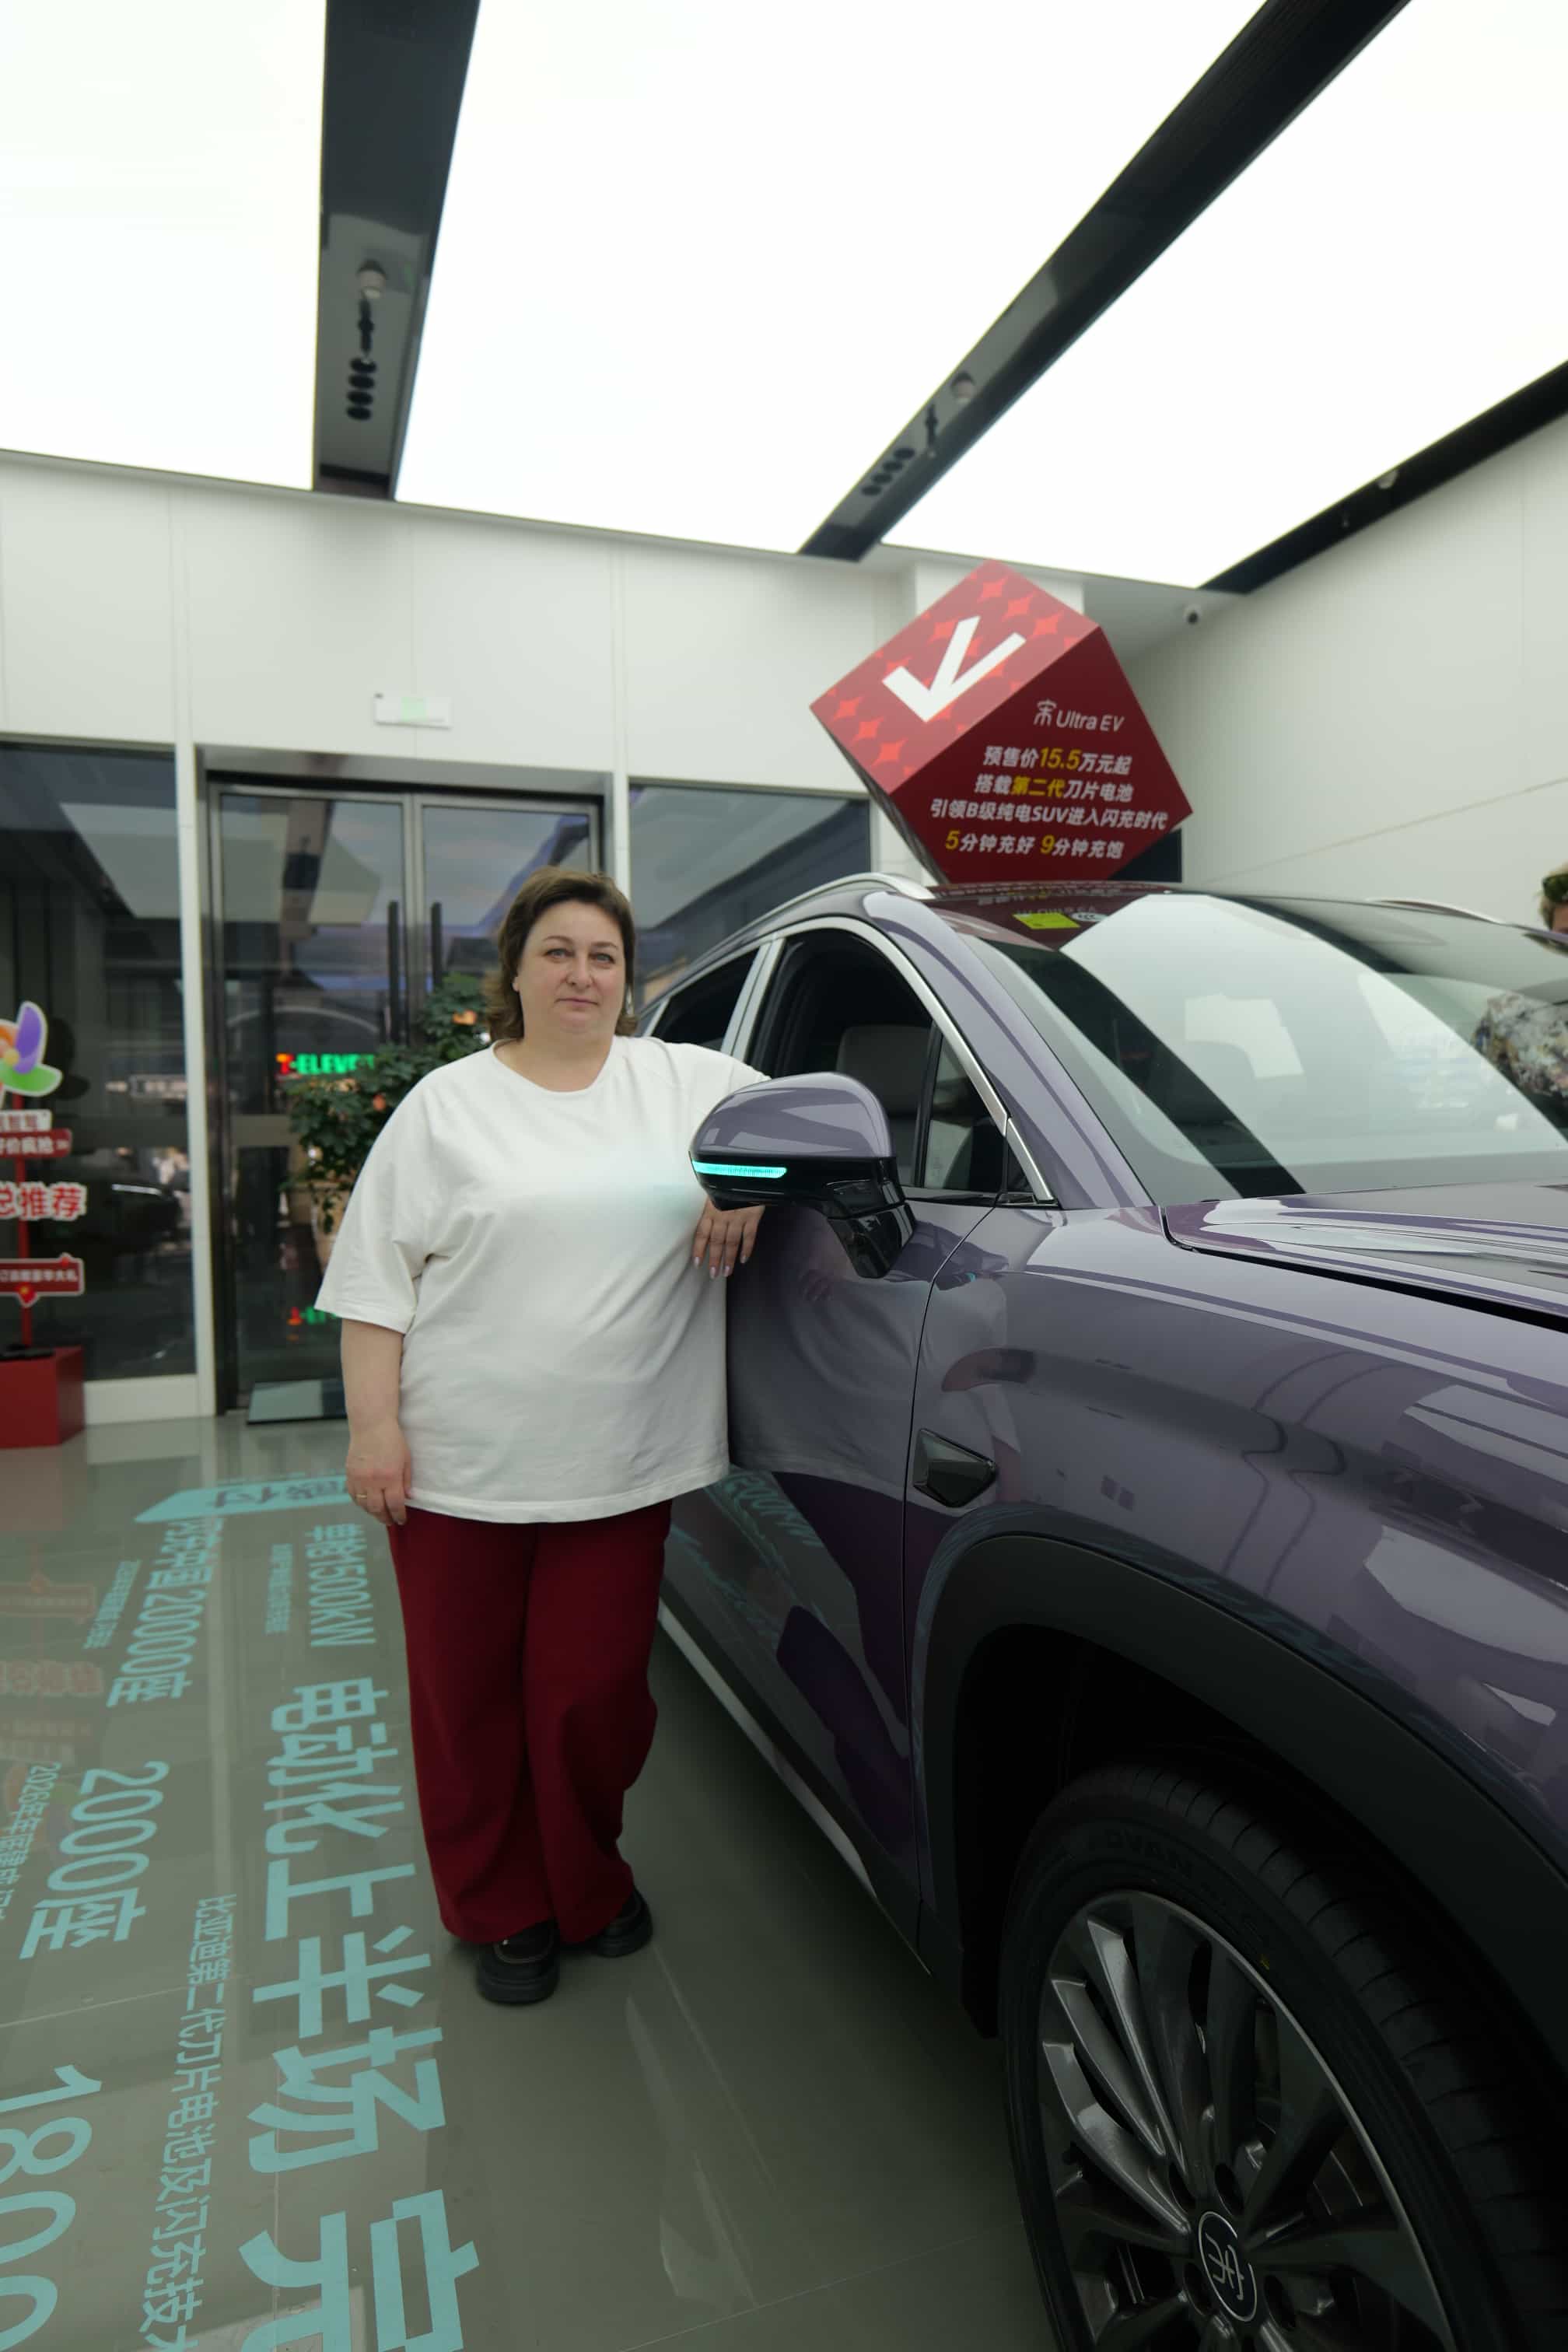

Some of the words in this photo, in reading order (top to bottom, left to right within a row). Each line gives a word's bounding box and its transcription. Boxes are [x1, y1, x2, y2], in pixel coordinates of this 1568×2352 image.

[1055, 709, 1097, 730] Ultra
[1099, 714, 1125, 732] EV
[982, 745, 1132, 775] 预售价15.5万元起
[974, 773, 1134, 803] 搭载第二代刀片电池
[930, 798, 1167, 830] 引领B级纯电SUV进入闪充时代
[945, 829, 1035, 855] 5分钟充好
[19, 1760, 170, 1960] 2000座
